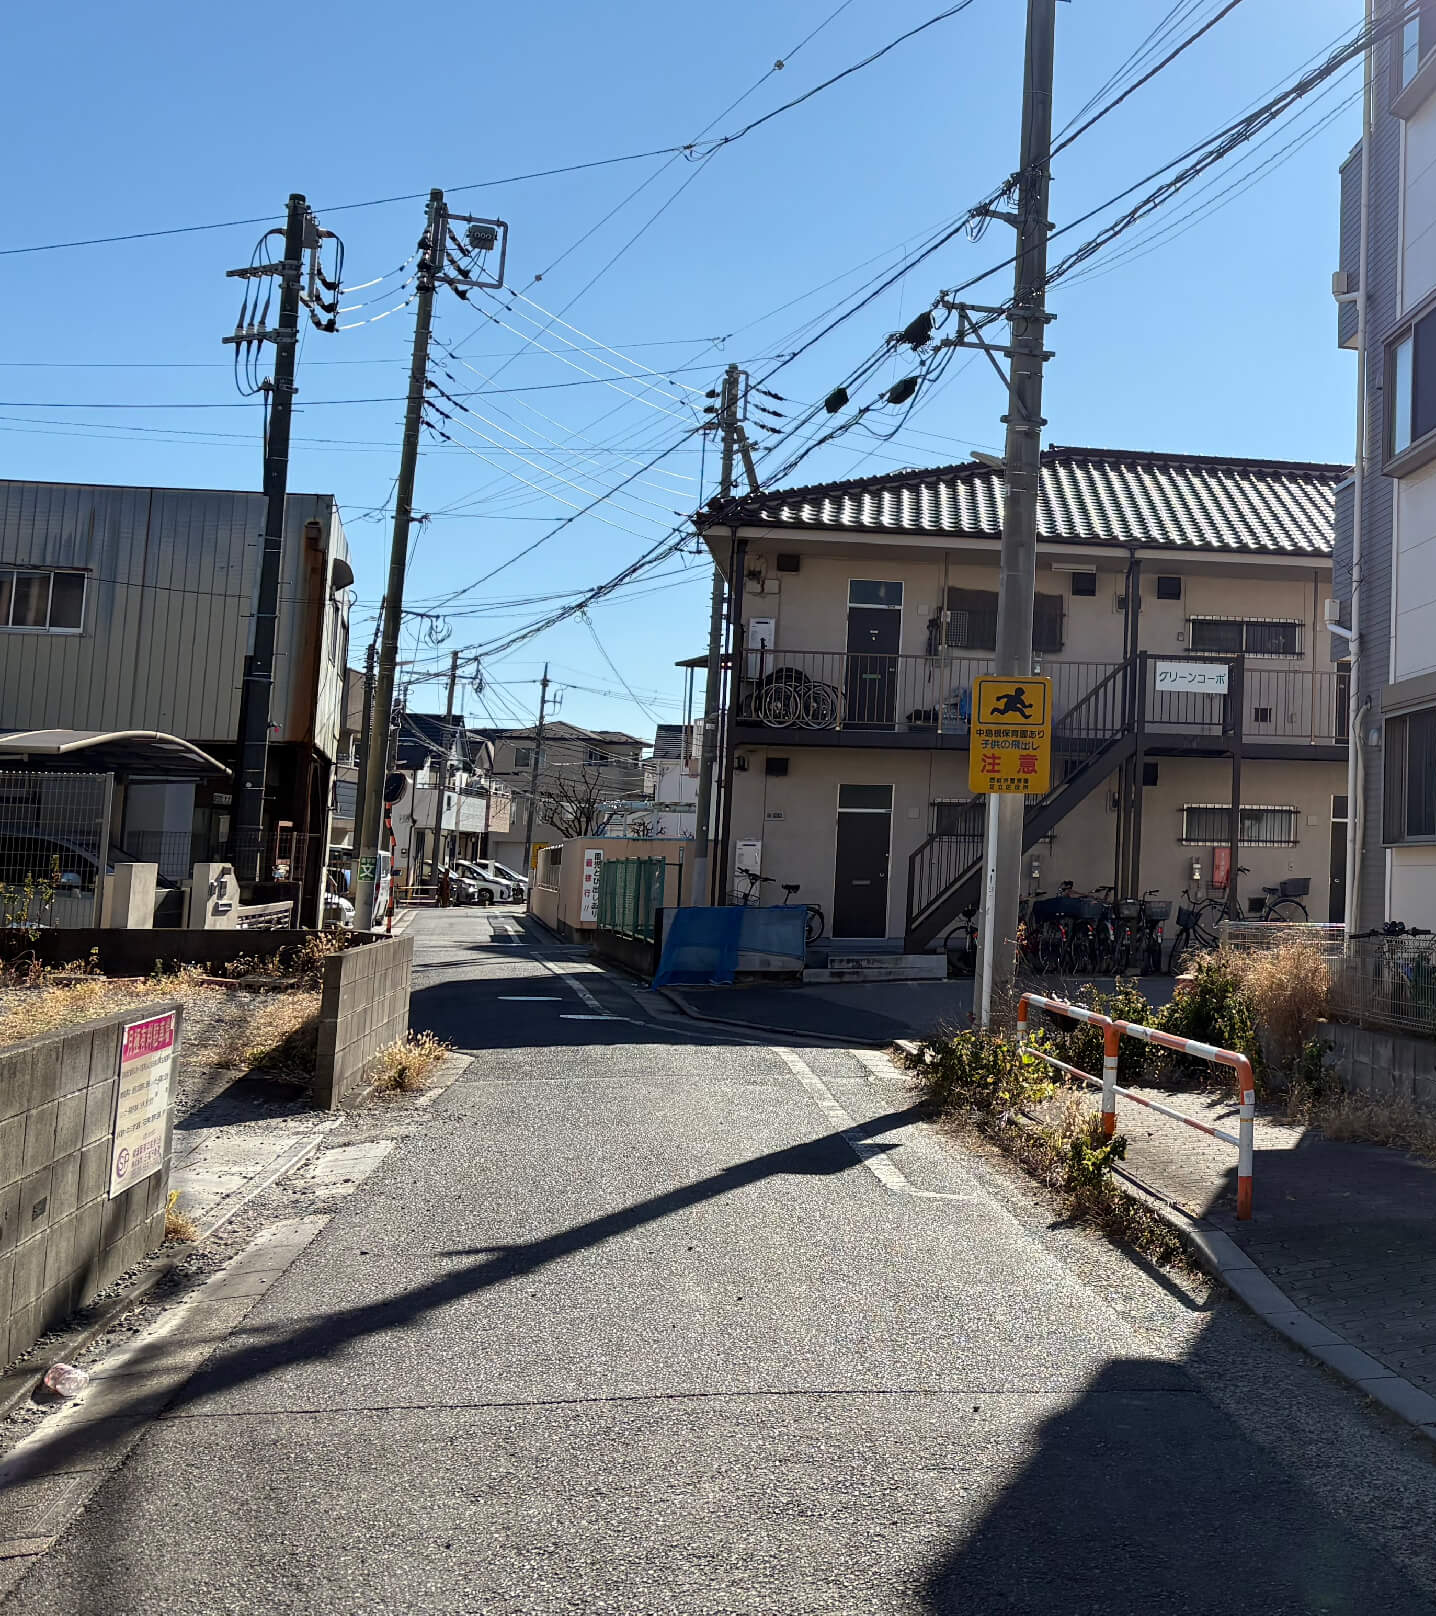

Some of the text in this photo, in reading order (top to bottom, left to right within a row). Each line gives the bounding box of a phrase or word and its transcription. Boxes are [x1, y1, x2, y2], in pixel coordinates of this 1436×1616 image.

[1159, 671, 1226, 685] グリーンコーポ
